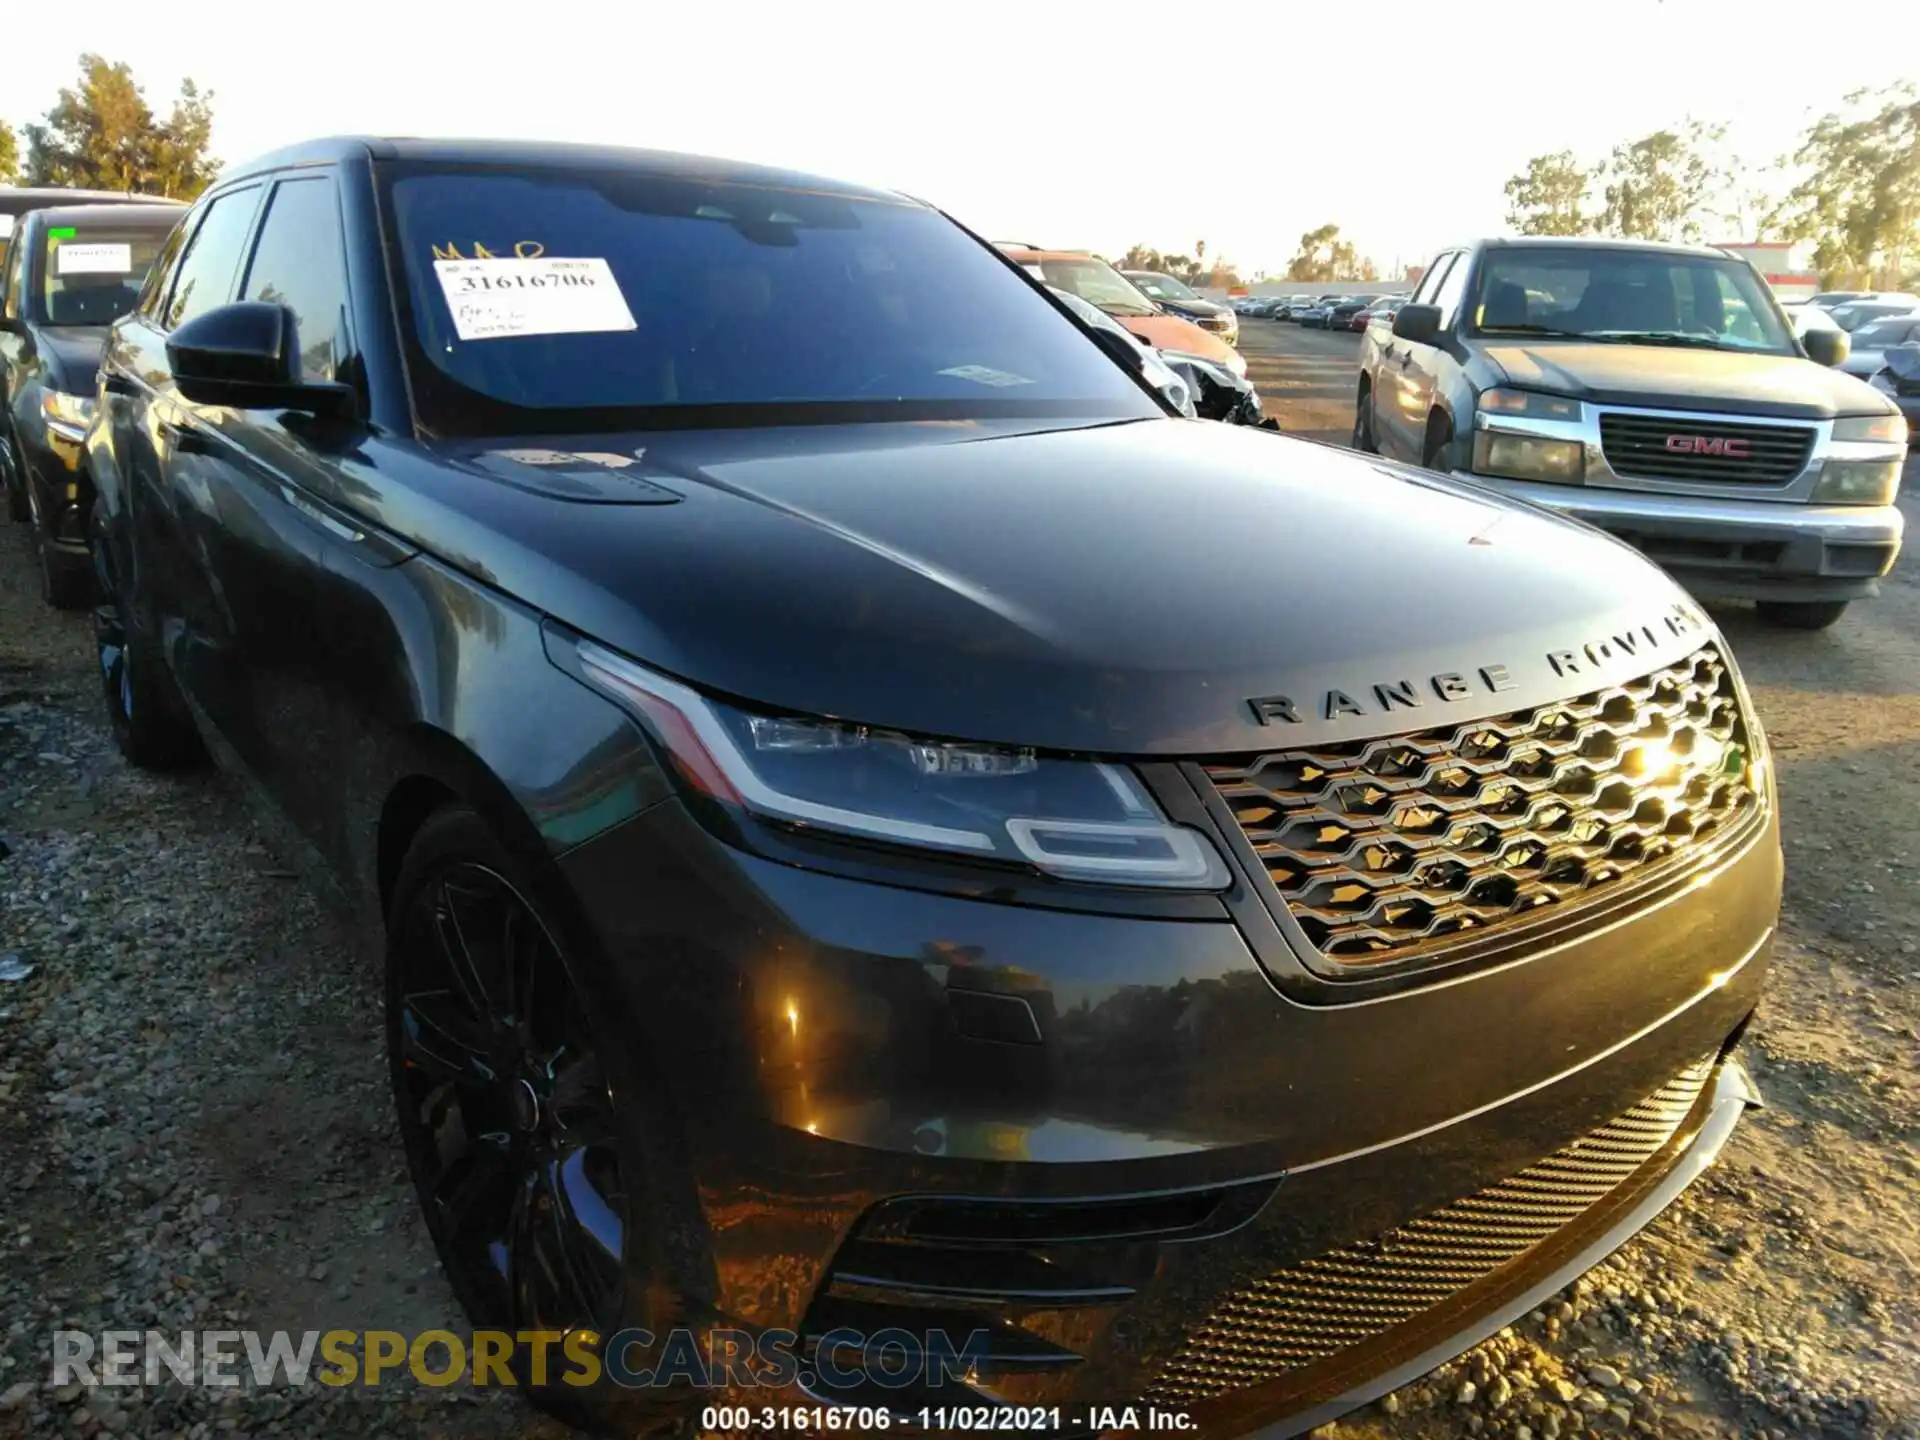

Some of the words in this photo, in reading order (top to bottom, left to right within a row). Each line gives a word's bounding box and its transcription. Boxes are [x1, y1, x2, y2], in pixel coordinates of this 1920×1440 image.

[460, 274, 595, 291] 31616706
[1667, 435, 1750, 456] GMC
[1247, 664, 1519, 726] RANGE
